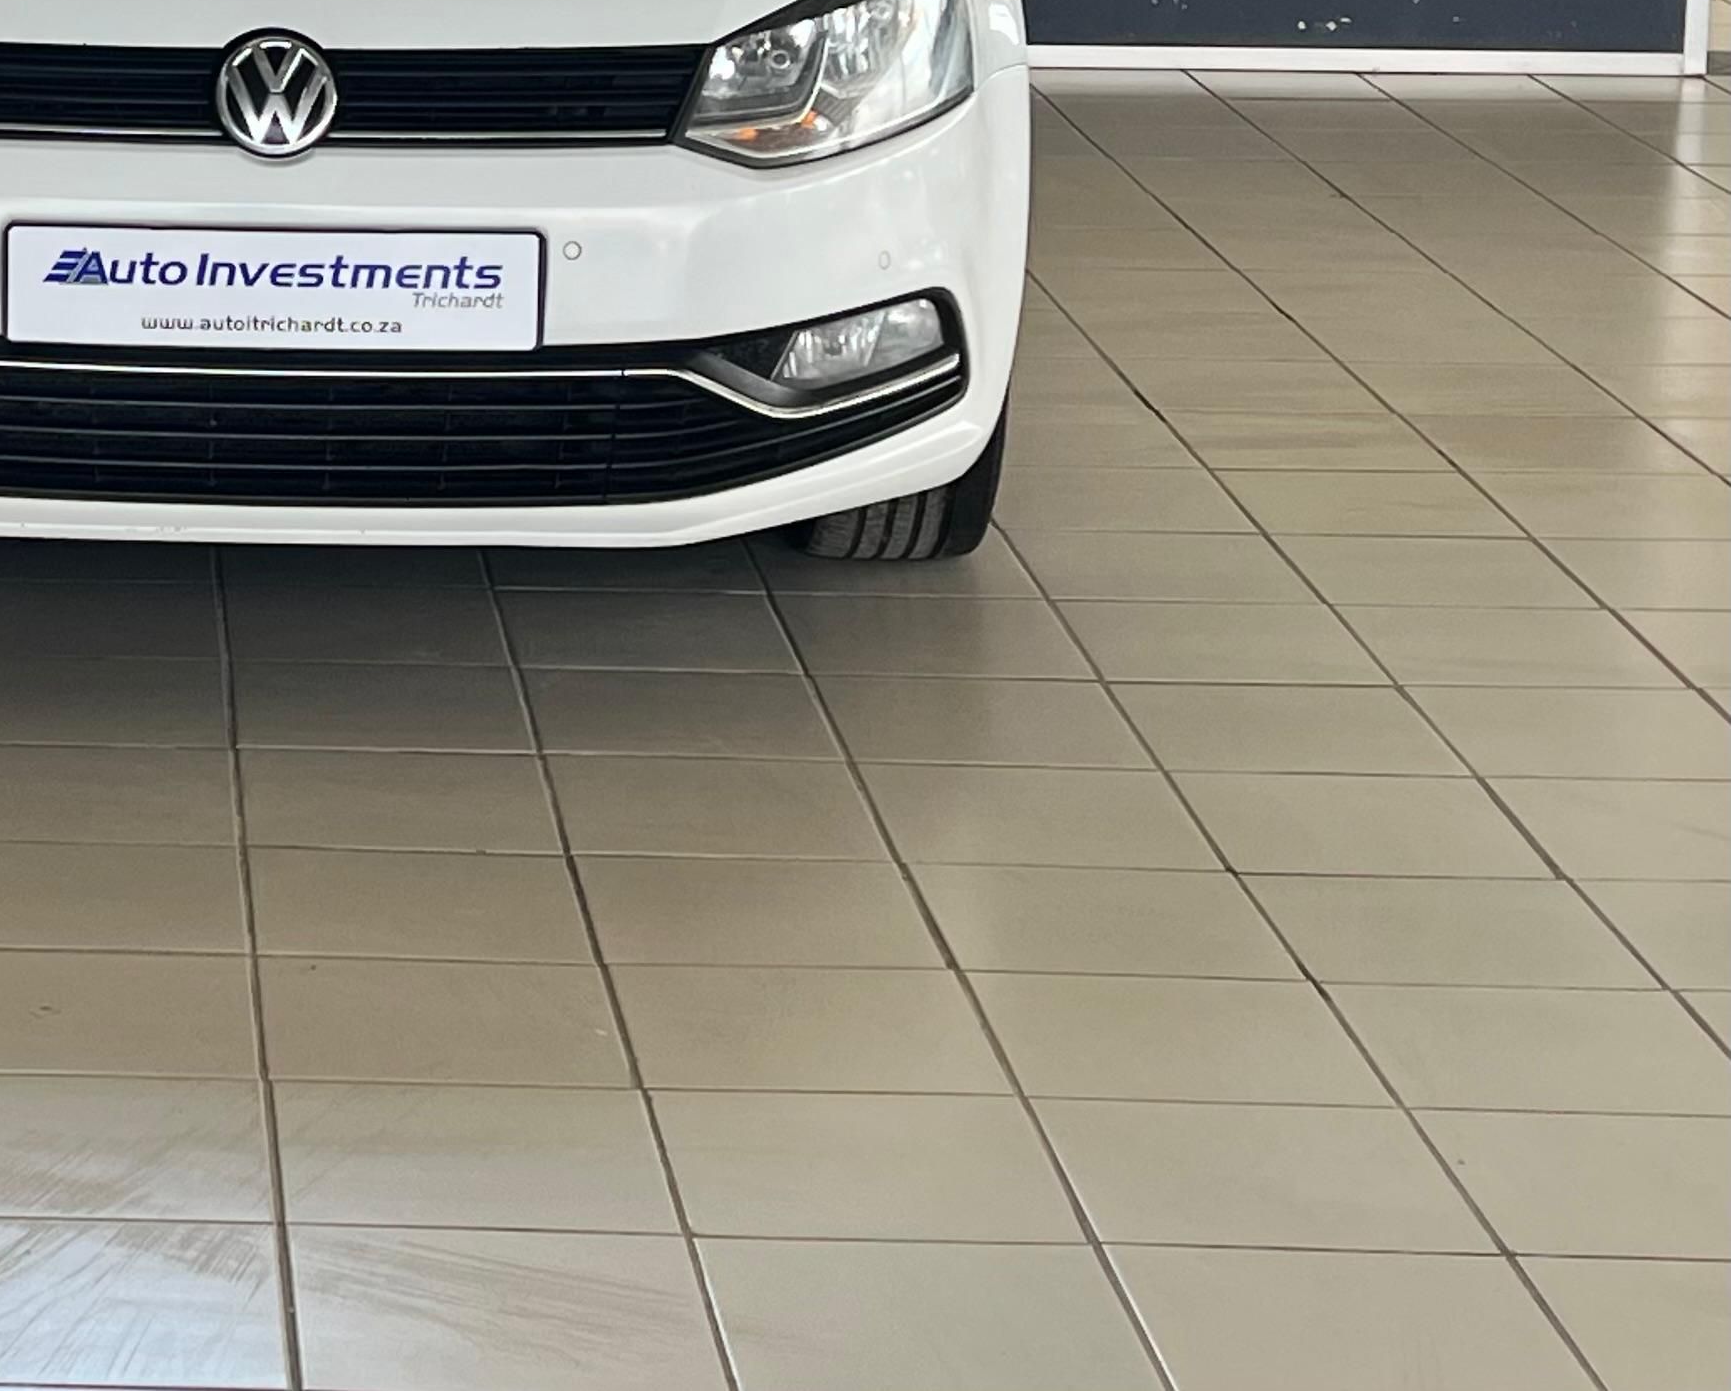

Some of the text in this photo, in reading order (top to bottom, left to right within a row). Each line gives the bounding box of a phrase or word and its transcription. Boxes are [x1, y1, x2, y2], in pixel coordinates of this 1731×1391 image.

[222, 43, 331, 149] VW
[72, 250, 504, 290] Auto Investments
[411, 291, 505, 309] Trichardt
[140, 315, 403, 334] www.autoitrichardt.co.za
